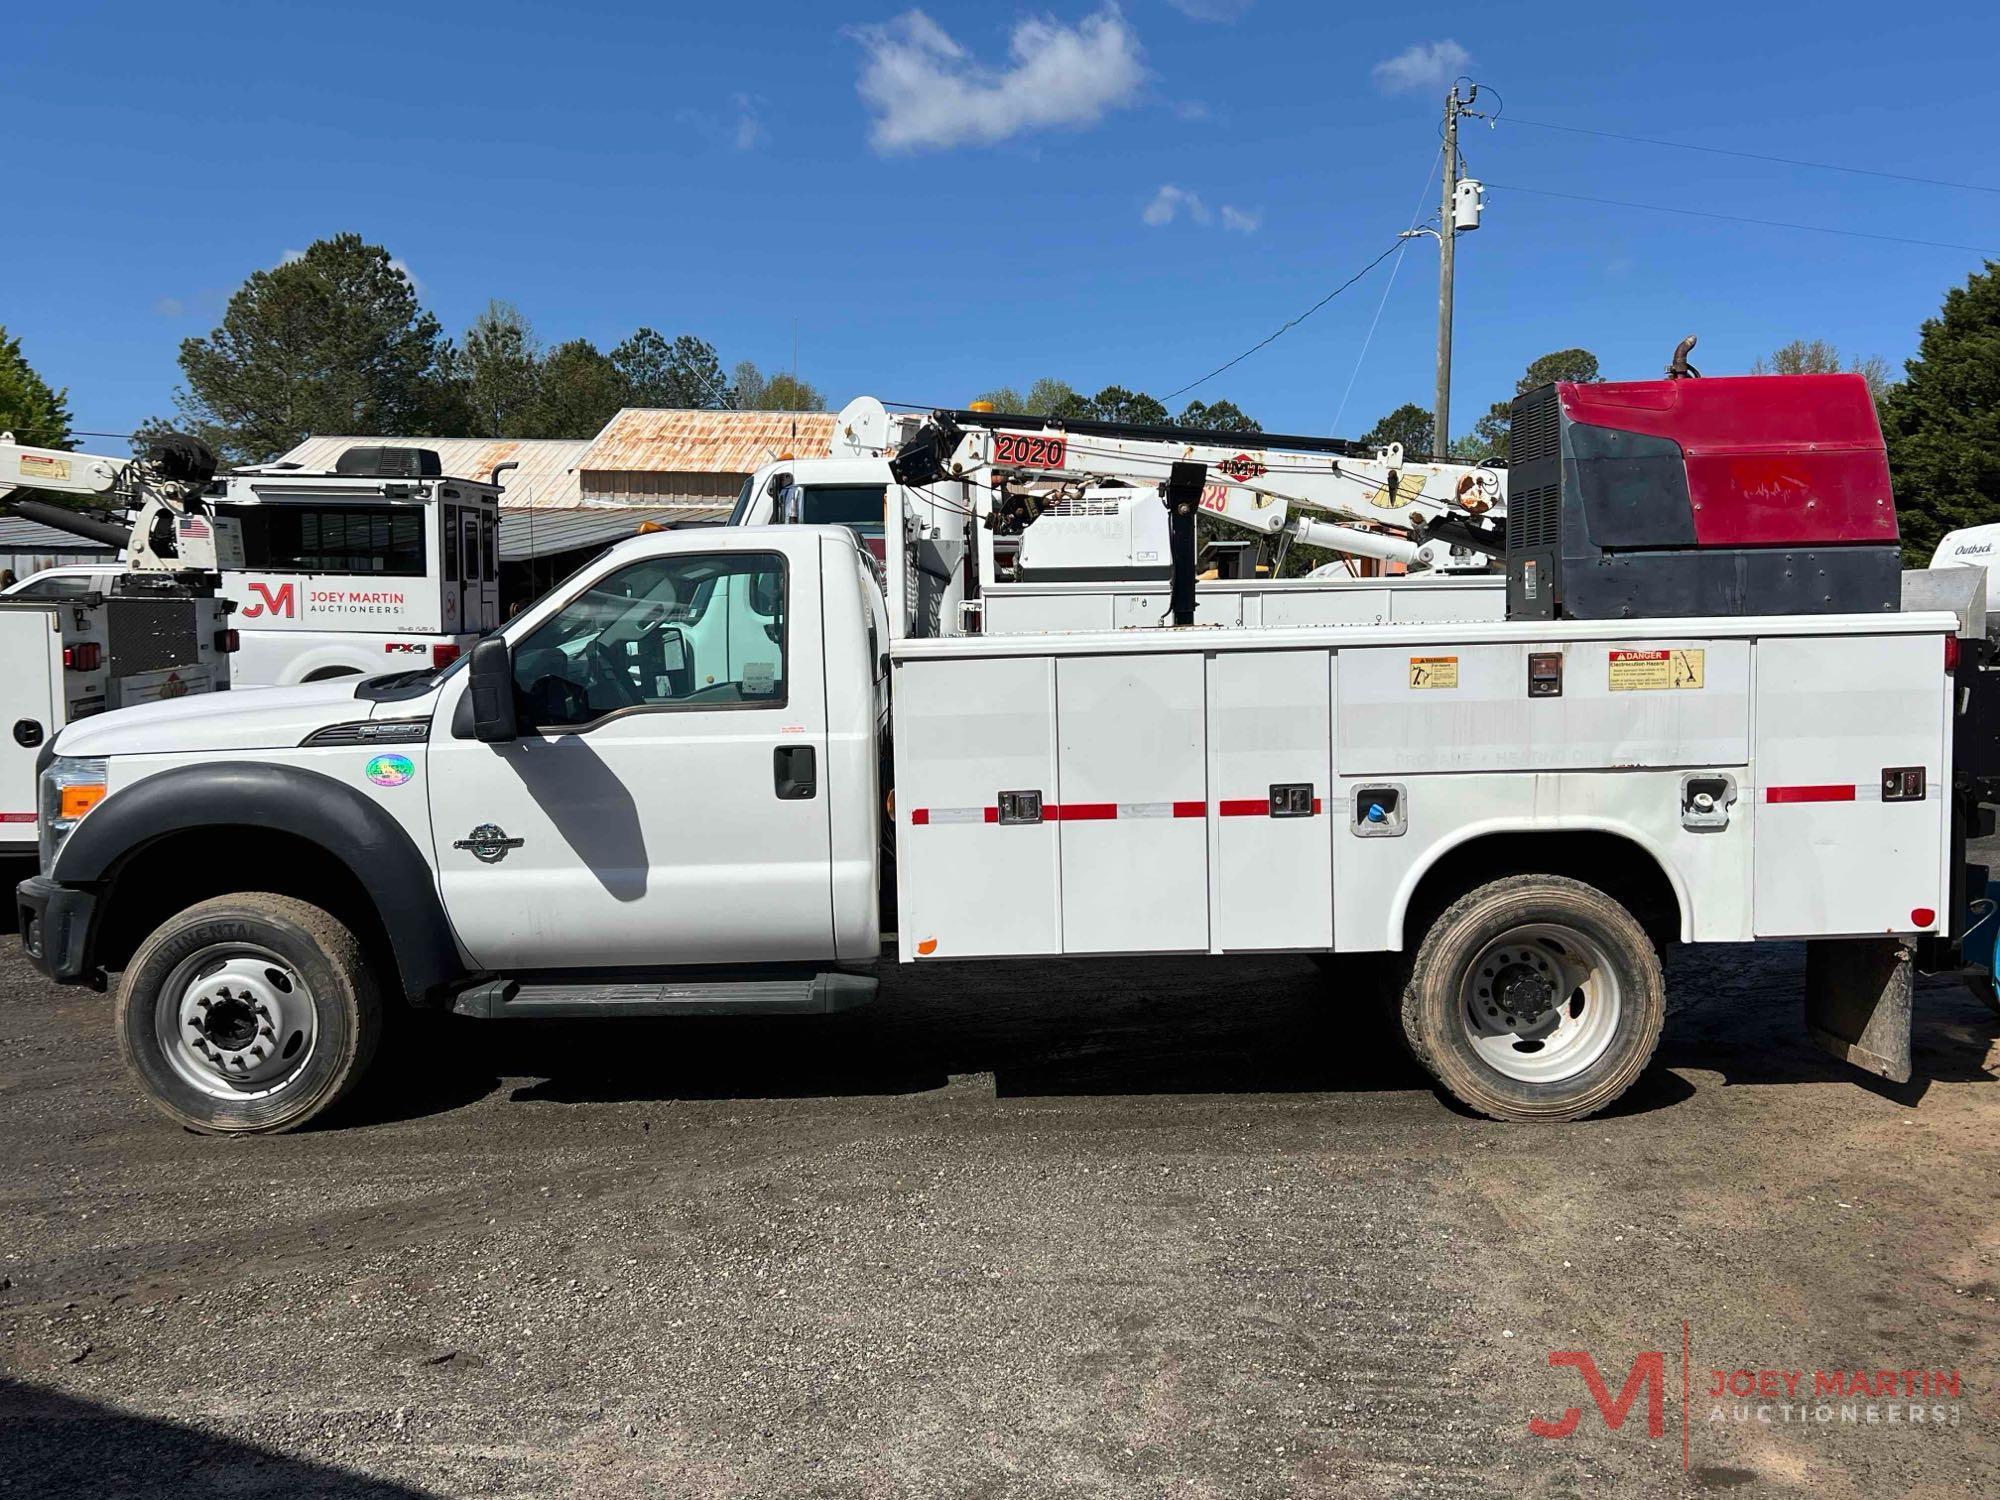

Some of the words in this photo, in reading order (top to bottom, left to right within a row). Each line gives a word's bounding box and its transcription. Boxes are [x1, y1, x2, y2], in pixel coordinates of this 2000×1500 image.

[996, 434, 1064, 465] 2020
[1221, 459, 1264, 477] IMT
[1954, 543, 1993, 555] Outback
[241, 582, 295, 618] JM
[310, 591, 345, 602] JOEY
[349, 592, 404, 604] MARTIN
[310, 605, 400, 614] AUCTIONEERS
[385, 643, 427, 653] FX4
[1626, 652, 1663, 660] DANGER
